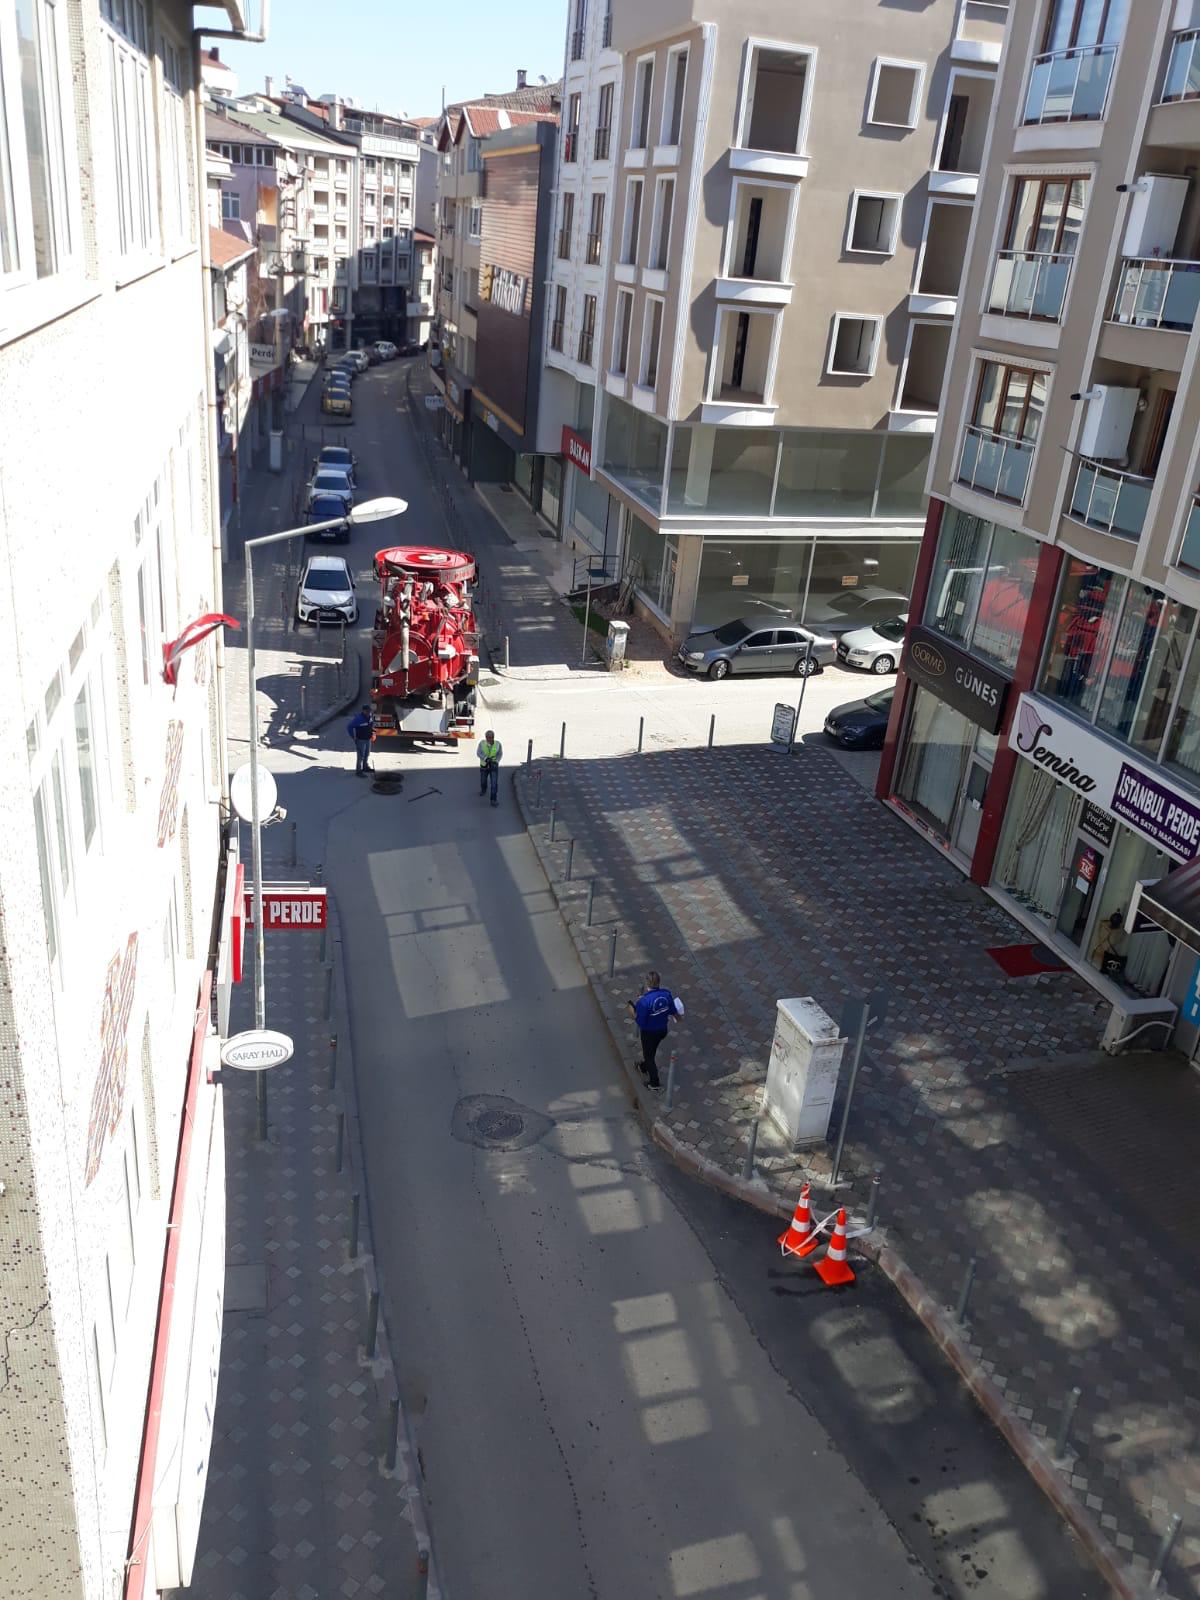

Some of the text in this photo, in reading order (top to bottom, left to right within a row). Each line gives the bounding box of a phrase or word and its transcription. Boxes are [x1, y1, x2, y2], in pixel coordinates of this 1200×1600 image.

[251, 347, 273, 358] Perd
[914, 645, 943, 672] DORME
[955, 667, 998, 707] GÜNEŞ
[1016, 723, 1097, 793] Semina
[1114, 801, 1140, 822] FABRİKA
[1117, 768, 1200, 845] İSTANBUL PERDE
[270, 901, 322, 923] PERDE
[232, 1049, 283, 1061] SARAY HALI
